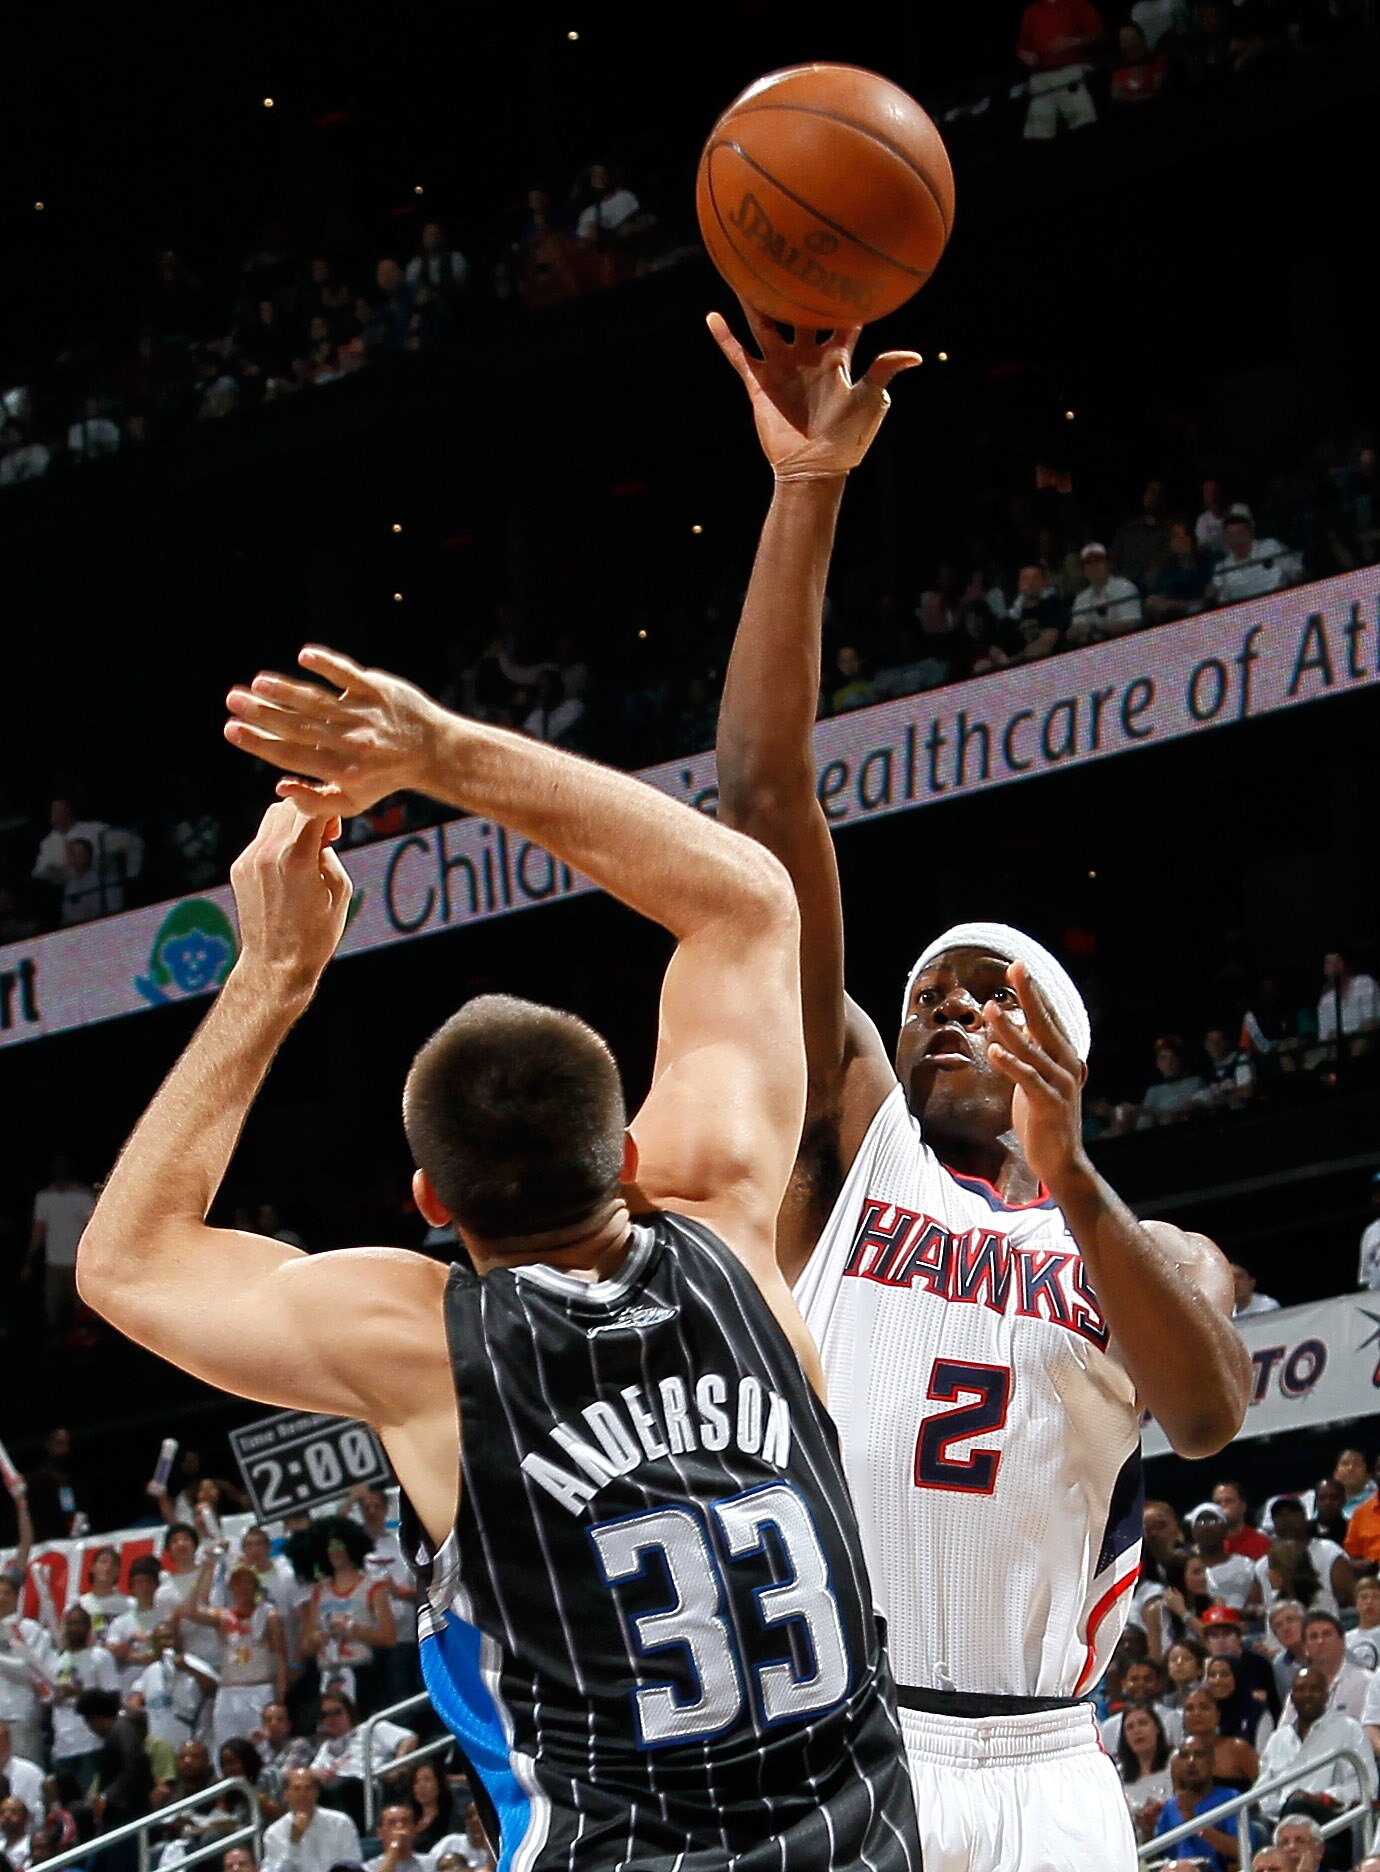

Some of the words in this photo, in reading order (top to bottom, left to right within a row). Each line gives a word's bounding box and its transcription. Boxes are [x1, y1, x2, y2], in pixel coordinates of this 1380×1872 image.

[728, 191, 886, 315] SPALDING
[818, 676, 1156, 818] ealthcare
[1185, 624, 1263, 722] of
[843, 1198, 1111, 1353] HAWKS
[251, 1428, 378, 1512] 2:00
[519, 1373, 793, 1517] ANDERSON
[914, 1357, 1011, 1495] 2
[585, 1480, 852, 1751] 33
